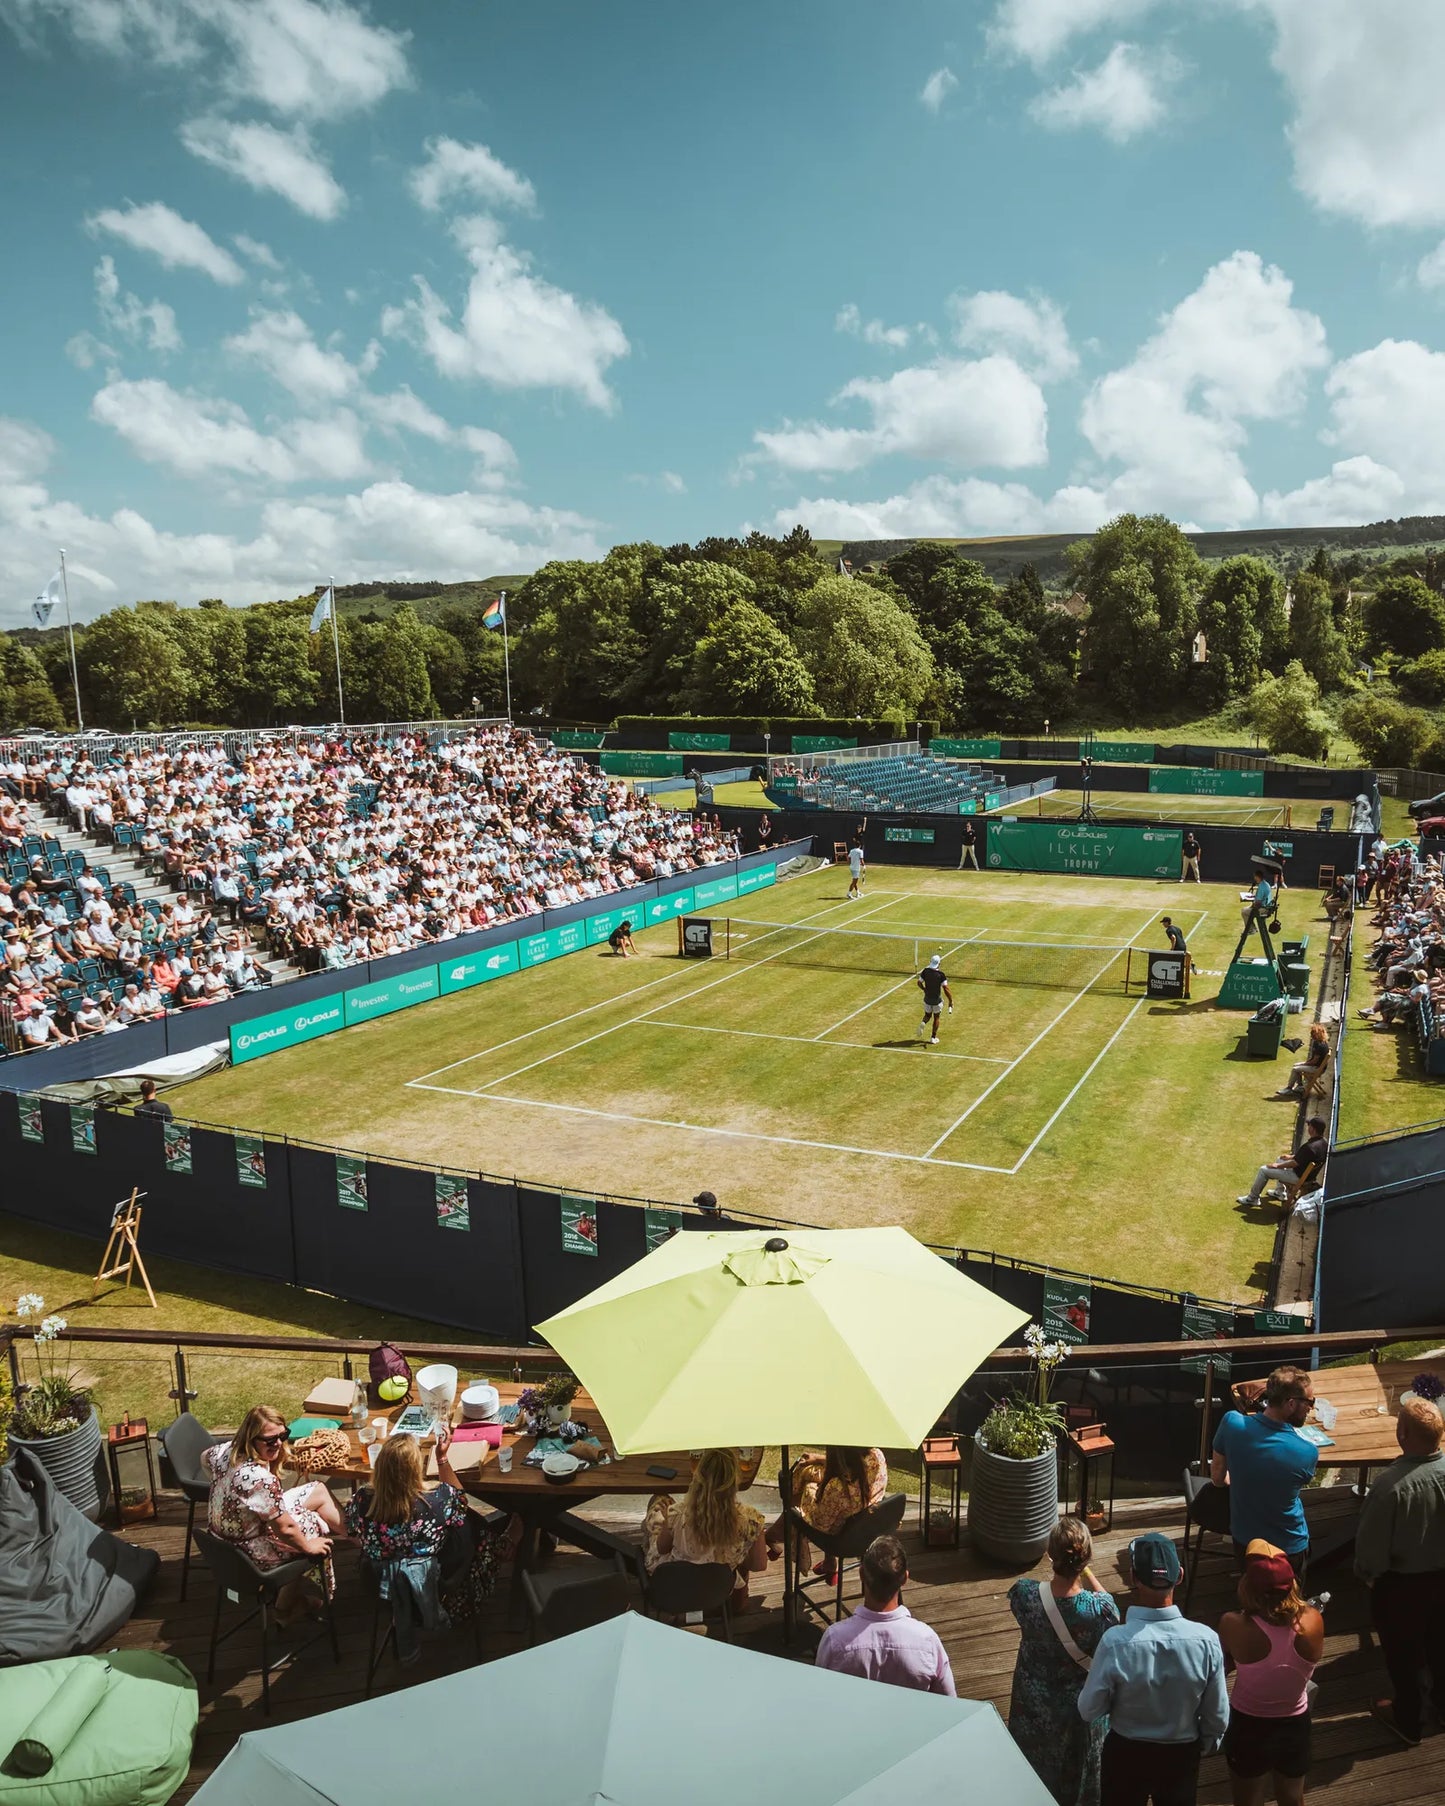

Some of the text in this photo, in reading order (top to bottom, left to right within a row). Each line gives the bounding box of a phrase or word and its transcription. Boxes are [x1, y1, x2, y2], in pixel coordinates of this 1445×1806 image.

[1186, 779, 1226, 787] ILKLEY
[1071, 831, 1108, 839] LEXUS
[1050, 842, 1115, 857] ILKLEY
[1064, 859, 1100, 869] TROPHY
[558, 932, 579, 946] ILKLEY
[527, 942, 550, 956] ILKLEY
[404, 980, 434, 995] Investec
[1150, 979, 1181, 987] CHALLENGER
[1227, 982, 1274, 993] ILKLEY
[358, 993, 390, 1009] Investec
[306, 1008, 340, 1025] LEXUS
[250, 1025, 288, 1043] LEXUS
[339, 1187, 352, 1196] 2017
[340, 1198, 364, 1208] CHAMPION
[563, 1232, 579, 1241] 2016
[564, 1242, 594, 1252] CHAMPION
[1046, 1293, 1069, 1303] KUDLA
[1045, 1318, 1064, 1328] 2015
[1185, 1313, 1216, 1323] CHAMPIONS
[1266, 1314, 1293, 1325] EXIT
[1045, 1329, 1083, 1343] CHAMPION
